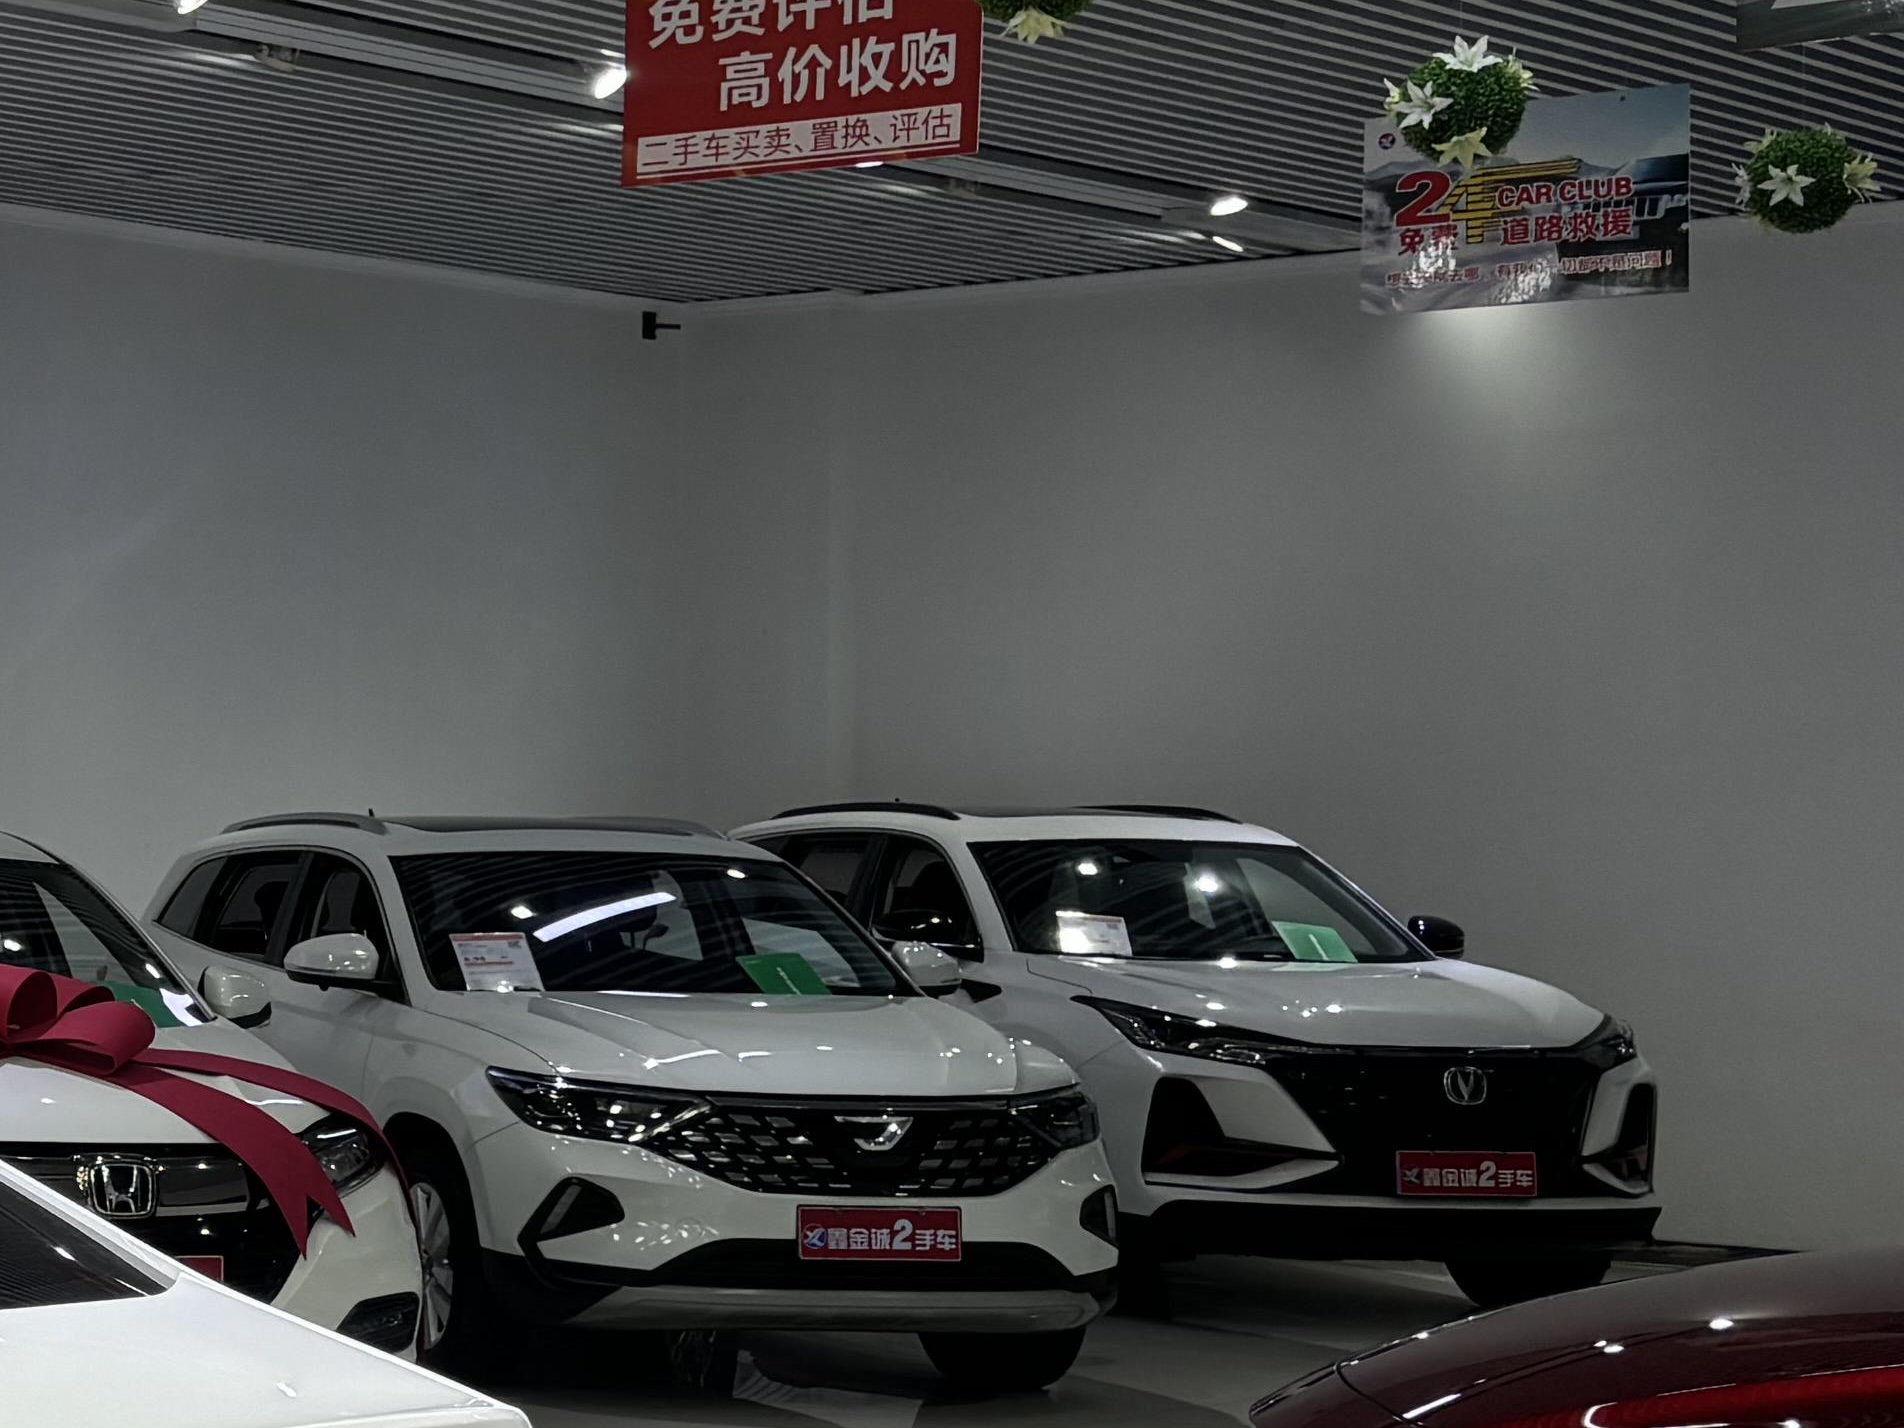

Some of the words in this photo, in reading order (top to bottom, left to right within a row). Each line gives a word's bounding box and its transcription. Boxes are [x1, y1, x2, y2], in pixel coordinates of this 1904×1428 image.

[718, 28, 958, 112] 高价收购
[642, 108, 953, 168] 二手车买卖、置换、评估
[1497, 182, 1553, 208] CAR
[1558, 176, 1634, 202] CLUB
[1500, 209, 1634, 246] 道路救援
[827, 1219, 957, 1251] 鑫金诚2手车
